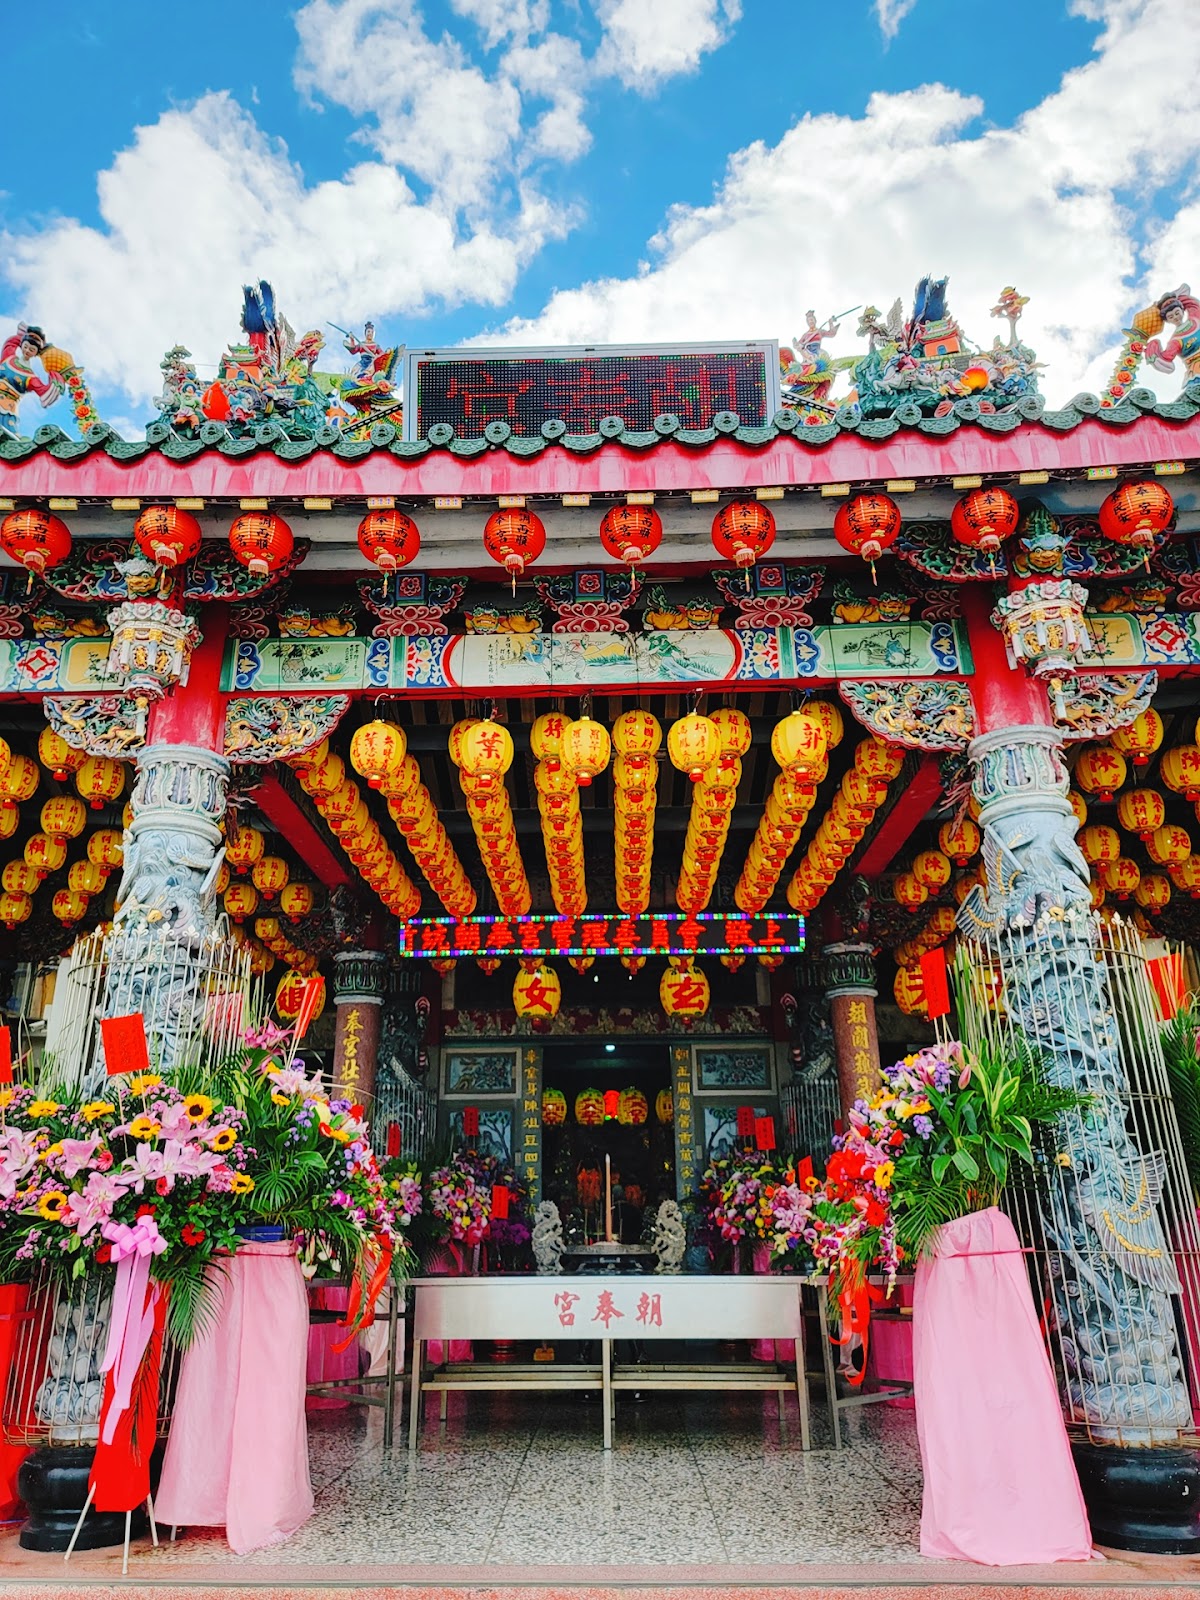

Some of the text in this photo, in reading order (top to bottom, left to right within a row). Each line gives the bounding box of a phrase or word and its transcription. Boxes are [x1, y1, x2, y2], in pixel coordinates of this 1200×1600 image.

[475, 731, 504, 760] 葉
[226, 885, 244, 904] 王
[291, 886, 309, 903] 王
[518, 977, 557, 1014] 女
[669, 974, 708, 1012] 玄
